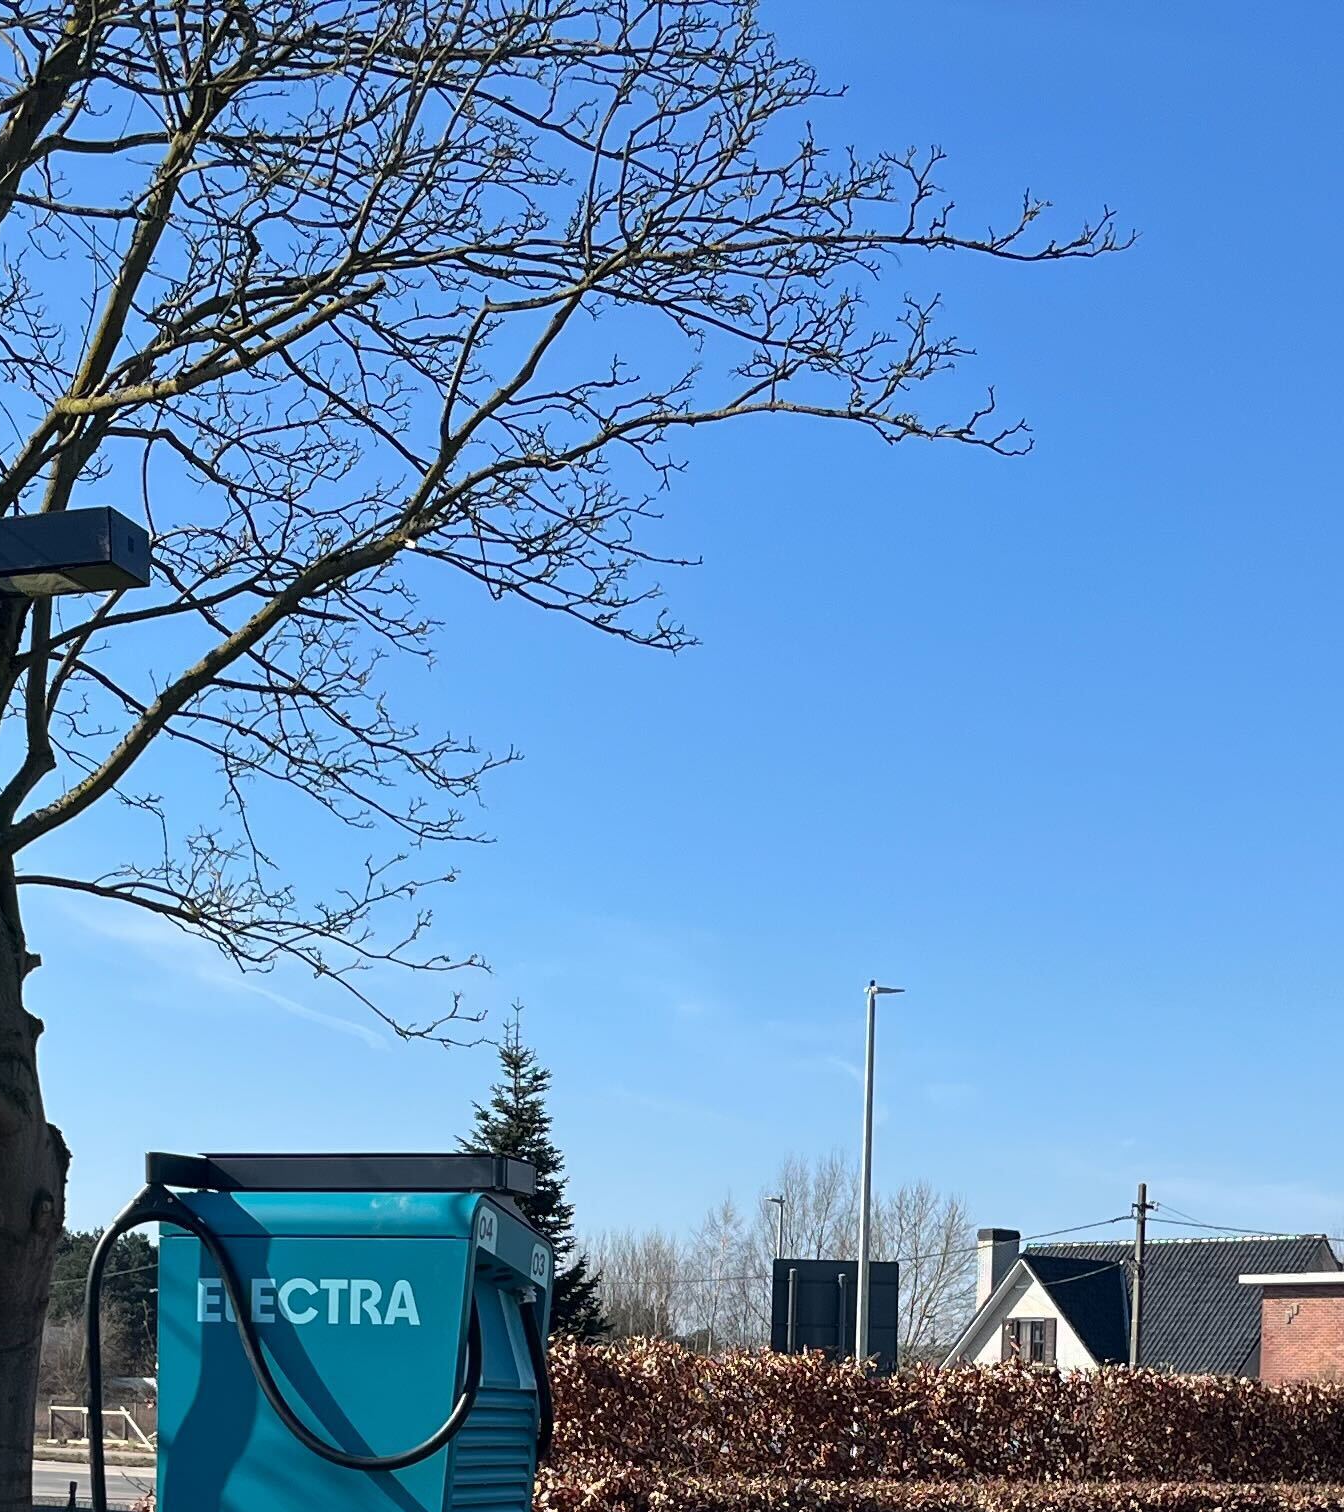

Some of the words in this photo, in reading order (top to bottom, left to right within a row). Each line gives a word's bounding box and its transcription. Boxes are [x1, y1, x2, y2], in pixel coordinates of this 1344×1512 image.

[479, 1216, 493, 1240] 04
[533, 1252, 545, 1277] 03
[197, 1278, 421, 1326] ELECTRA
